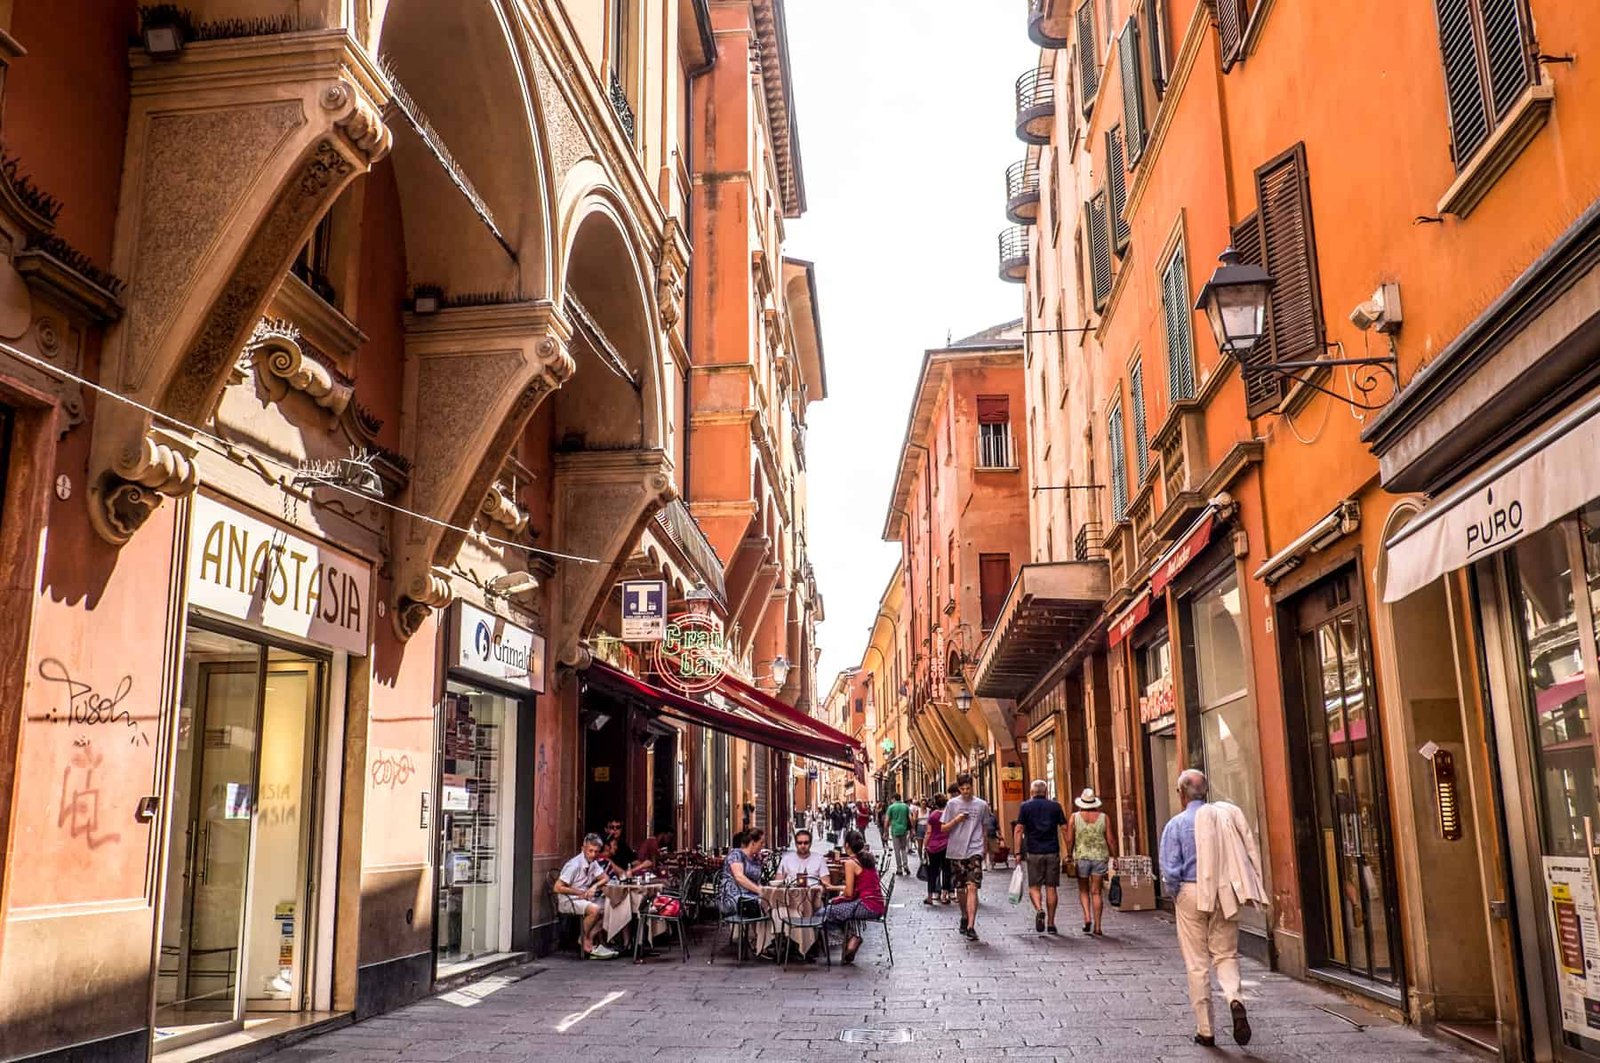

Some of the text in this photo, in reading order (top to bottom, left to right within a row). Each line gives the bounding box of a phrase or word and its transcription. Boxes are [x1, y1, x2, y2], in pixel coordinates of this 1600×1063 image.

[1467, 500, 1522, 550] PURO
[200, 520, 361, 633] ANASTASIA
[626, 584, 660, 612] T
[493, 633, 535, 673] Grimaldi
[662, 624, 724, 656] Gran
[680, 652, 722, 675] bar
